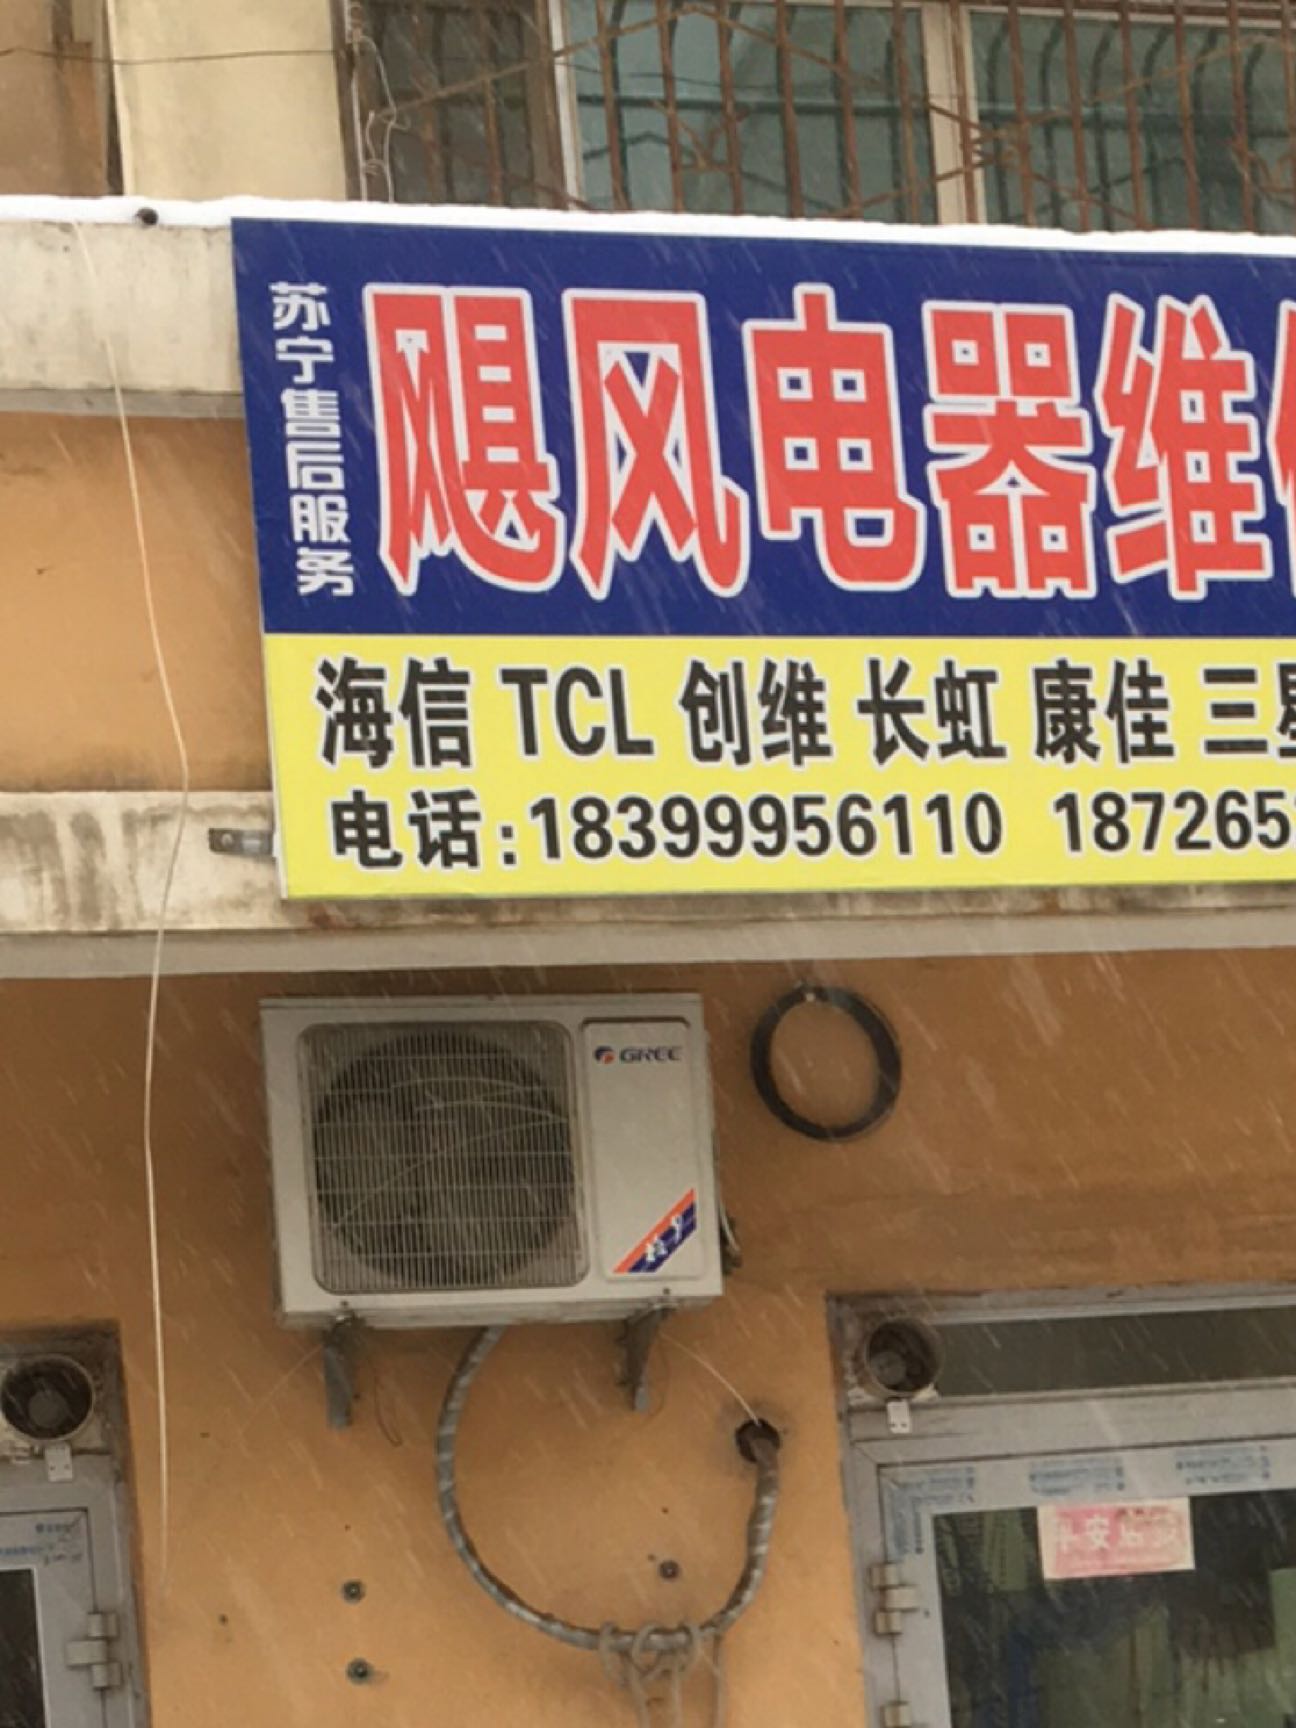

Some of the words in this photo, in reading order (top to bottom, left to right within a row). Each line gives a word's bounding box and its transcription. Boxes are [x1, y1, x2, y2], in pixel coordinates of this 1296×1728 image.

[269, 281, 355, 597] 苏宁售后服务
[315, 656, 472, 769] 海信
[501, 667, 654, 757] TCL
[679, 660, 832, 766] 创维
[857, 659, 1006, 764] 长虹
[1034, 659, 1175, 764] 康佳
